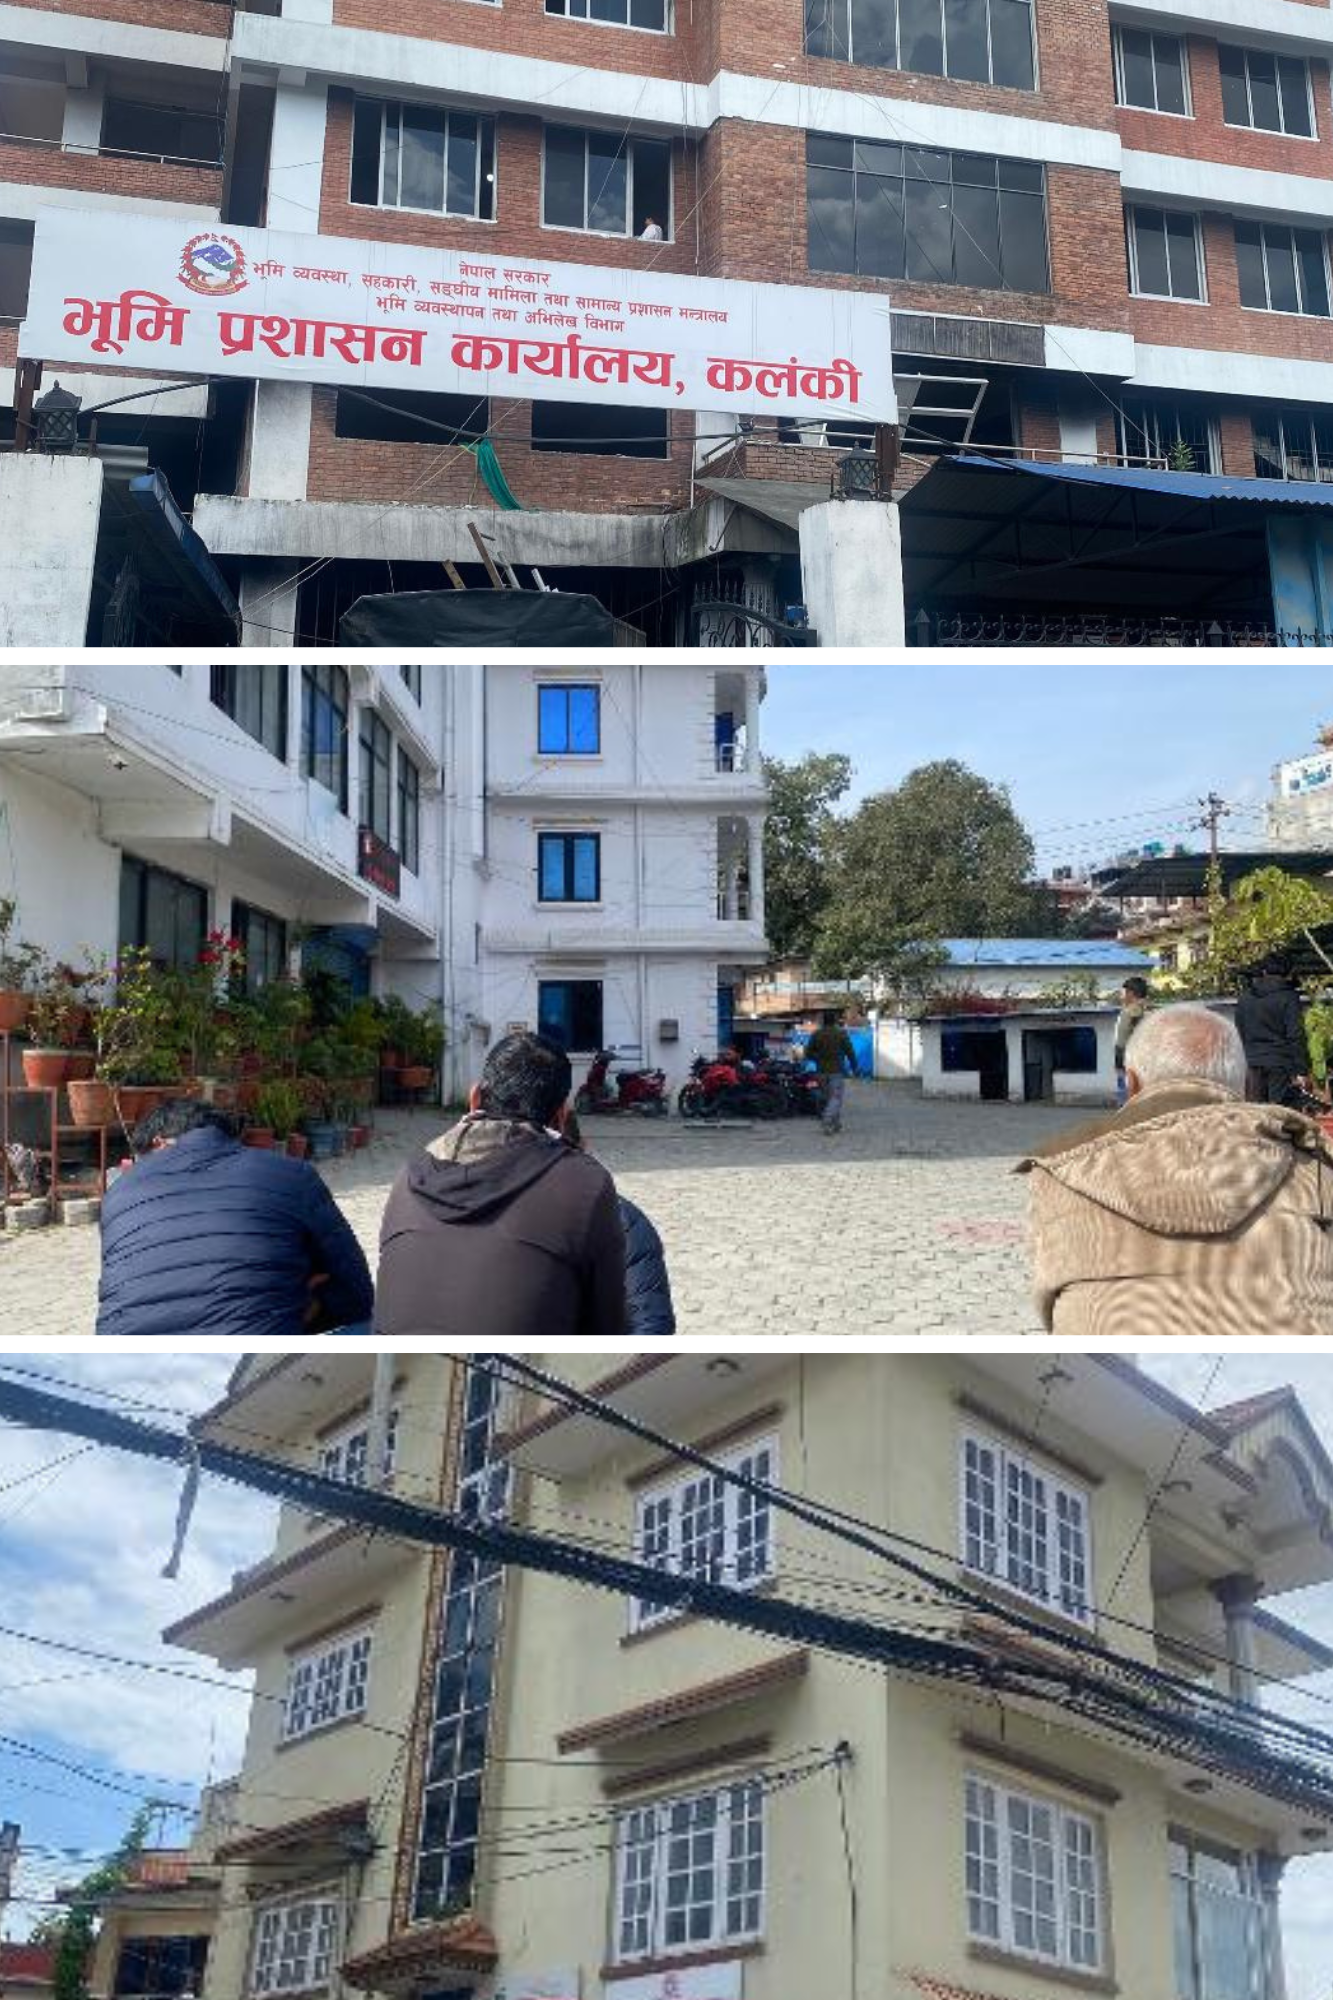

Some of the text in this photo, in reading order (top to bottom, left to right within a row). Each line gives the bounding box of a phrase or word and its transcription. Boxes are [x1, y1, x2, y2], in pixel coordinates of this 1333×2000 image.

[252, 259, 286, 280] भूमि
[487, 285, 538, 305] मामिला
[543, 293, 571, 309] तथा
[627, 302, 674, 318] प्रशासन
[459, 261, 552, 287] नेपाल सरकार
[376, 293, 626, 333] भूमि व्यवस्थापन तथा अभिलेख विभाग
[62, 289, 864, 404] भूमि प्रशासन कार्यालय, कलंकी
